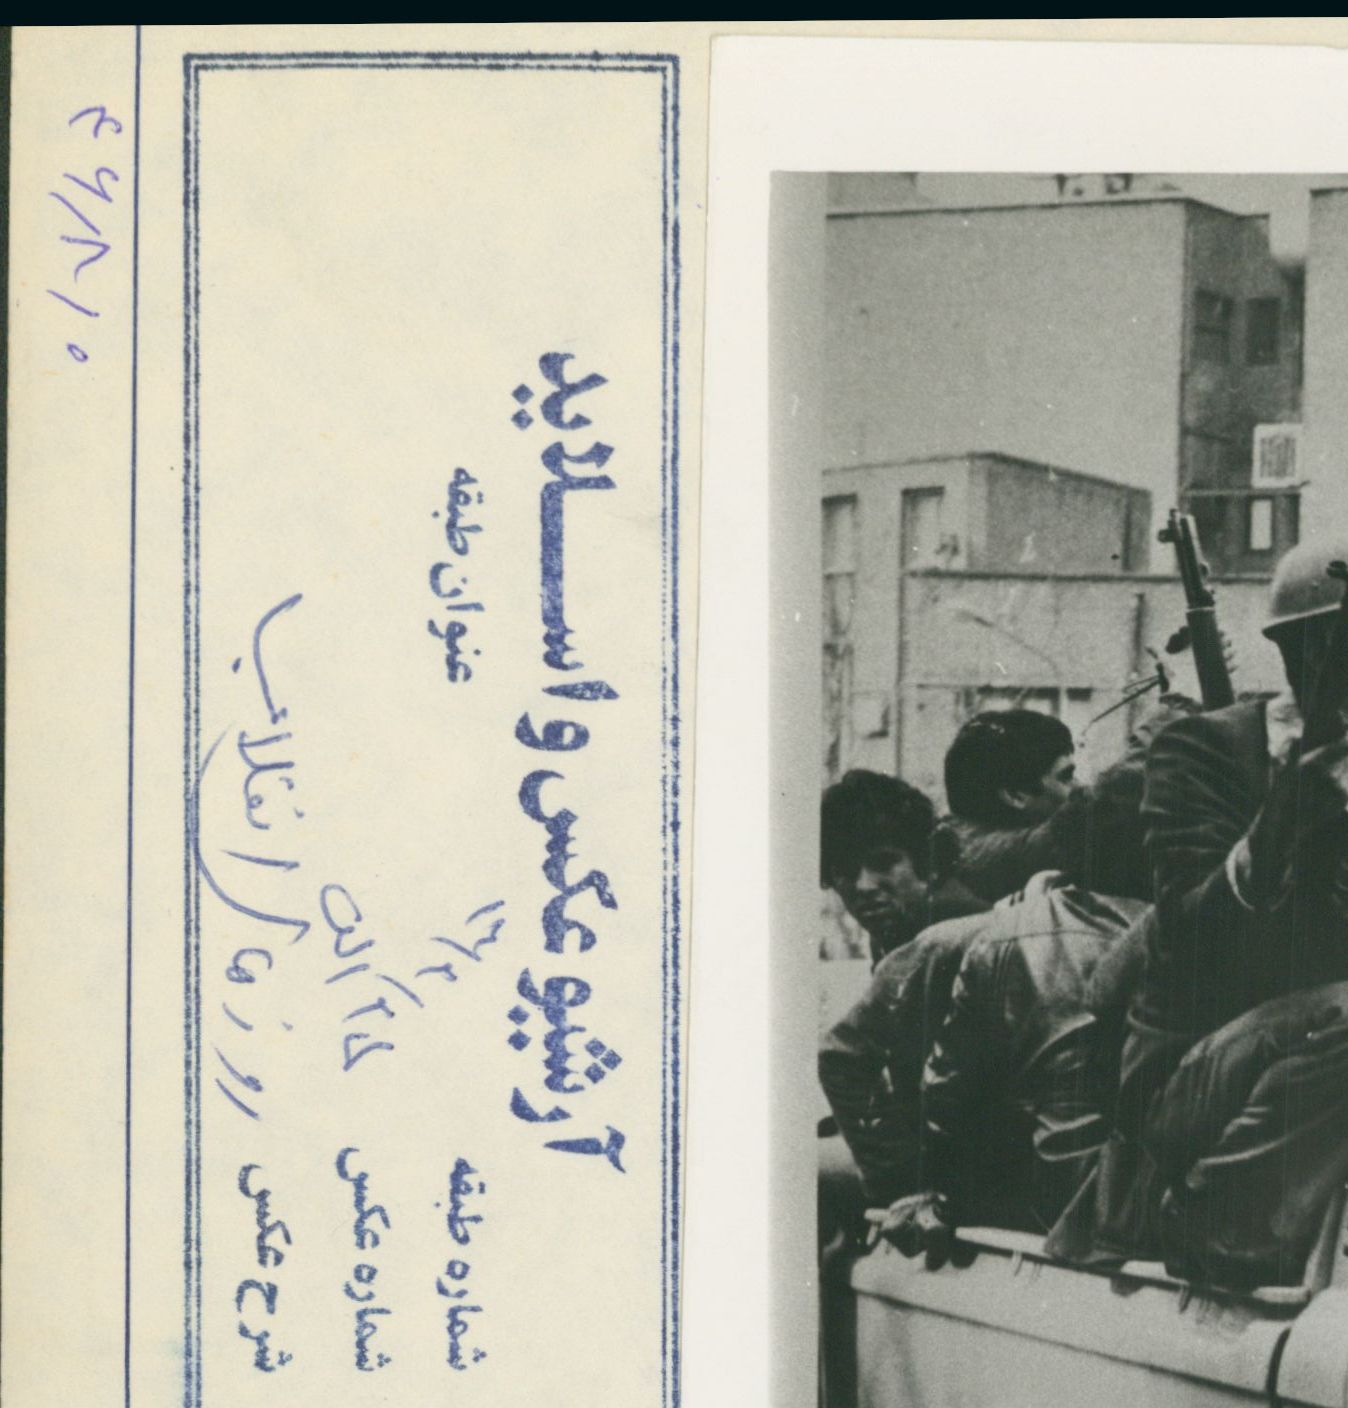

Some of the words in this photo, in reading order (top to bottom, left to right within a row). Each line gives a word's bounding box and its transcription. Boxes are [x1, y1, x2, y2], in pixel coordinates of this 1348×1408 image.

[432, 467, 483, 556] طبقه
[511, 352, 619, 701] اسلاید
[428, 562, 484, 683] عنوان
[515, 714, 590, 752] و
[518, 769, 618, 954] عکس
[507, 968, 626, 1173] آرشیو
[238, 1164, 292, 1268] عکس
[335, 1147, 391, 1250] عکس
[435, 1158, 486, 1246] طبقه
[235, 1279, 293, 1373] شرح
[344, 1264, 392, 1371] شماره
[436, 1259, 487, 1371] شماره
